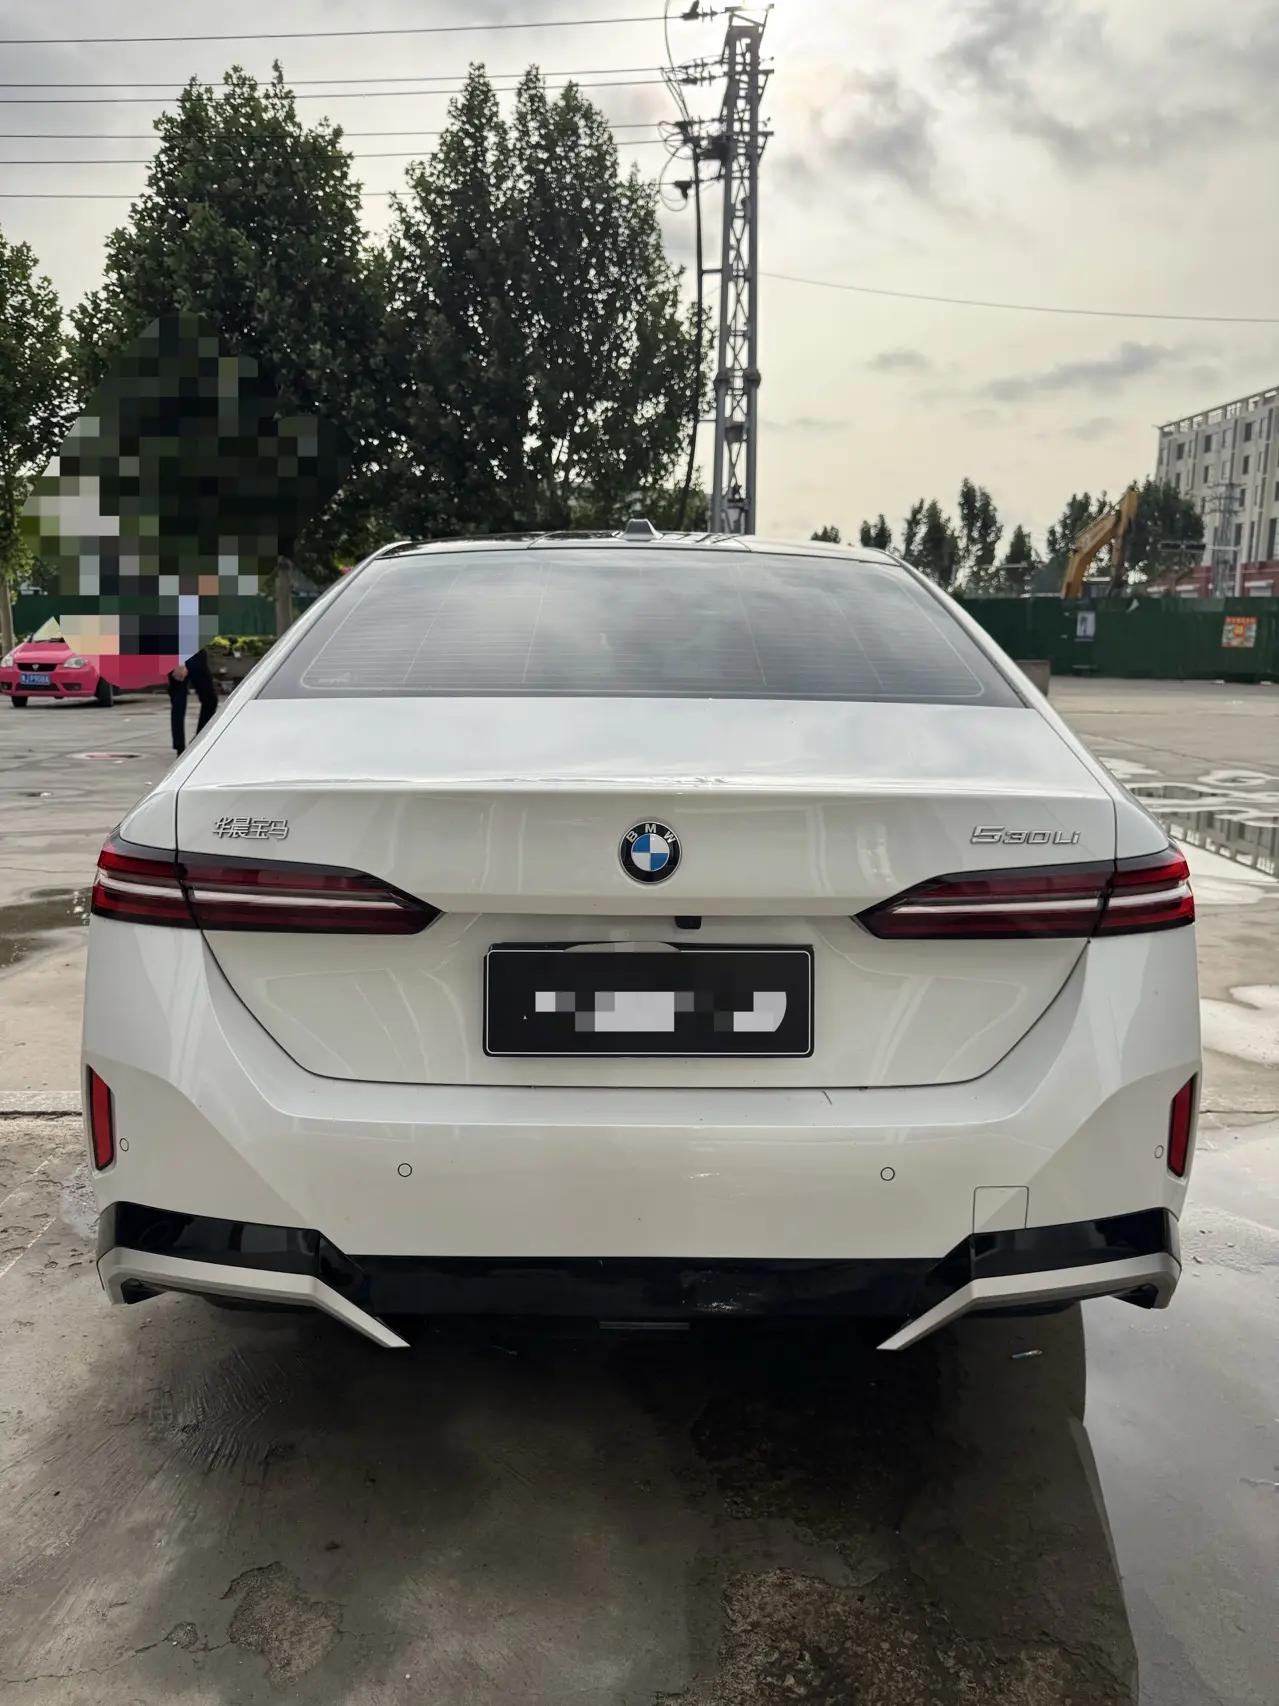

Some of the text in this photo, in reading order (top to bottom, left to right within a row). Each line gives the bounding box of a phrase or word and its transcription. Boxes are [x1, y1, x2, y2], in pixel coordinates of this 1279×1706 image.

[212, 817, 290, 840] 华晨宝马
[626, 823, 677, 844] BMW
[970, 825, 1081, 845] 530Li
